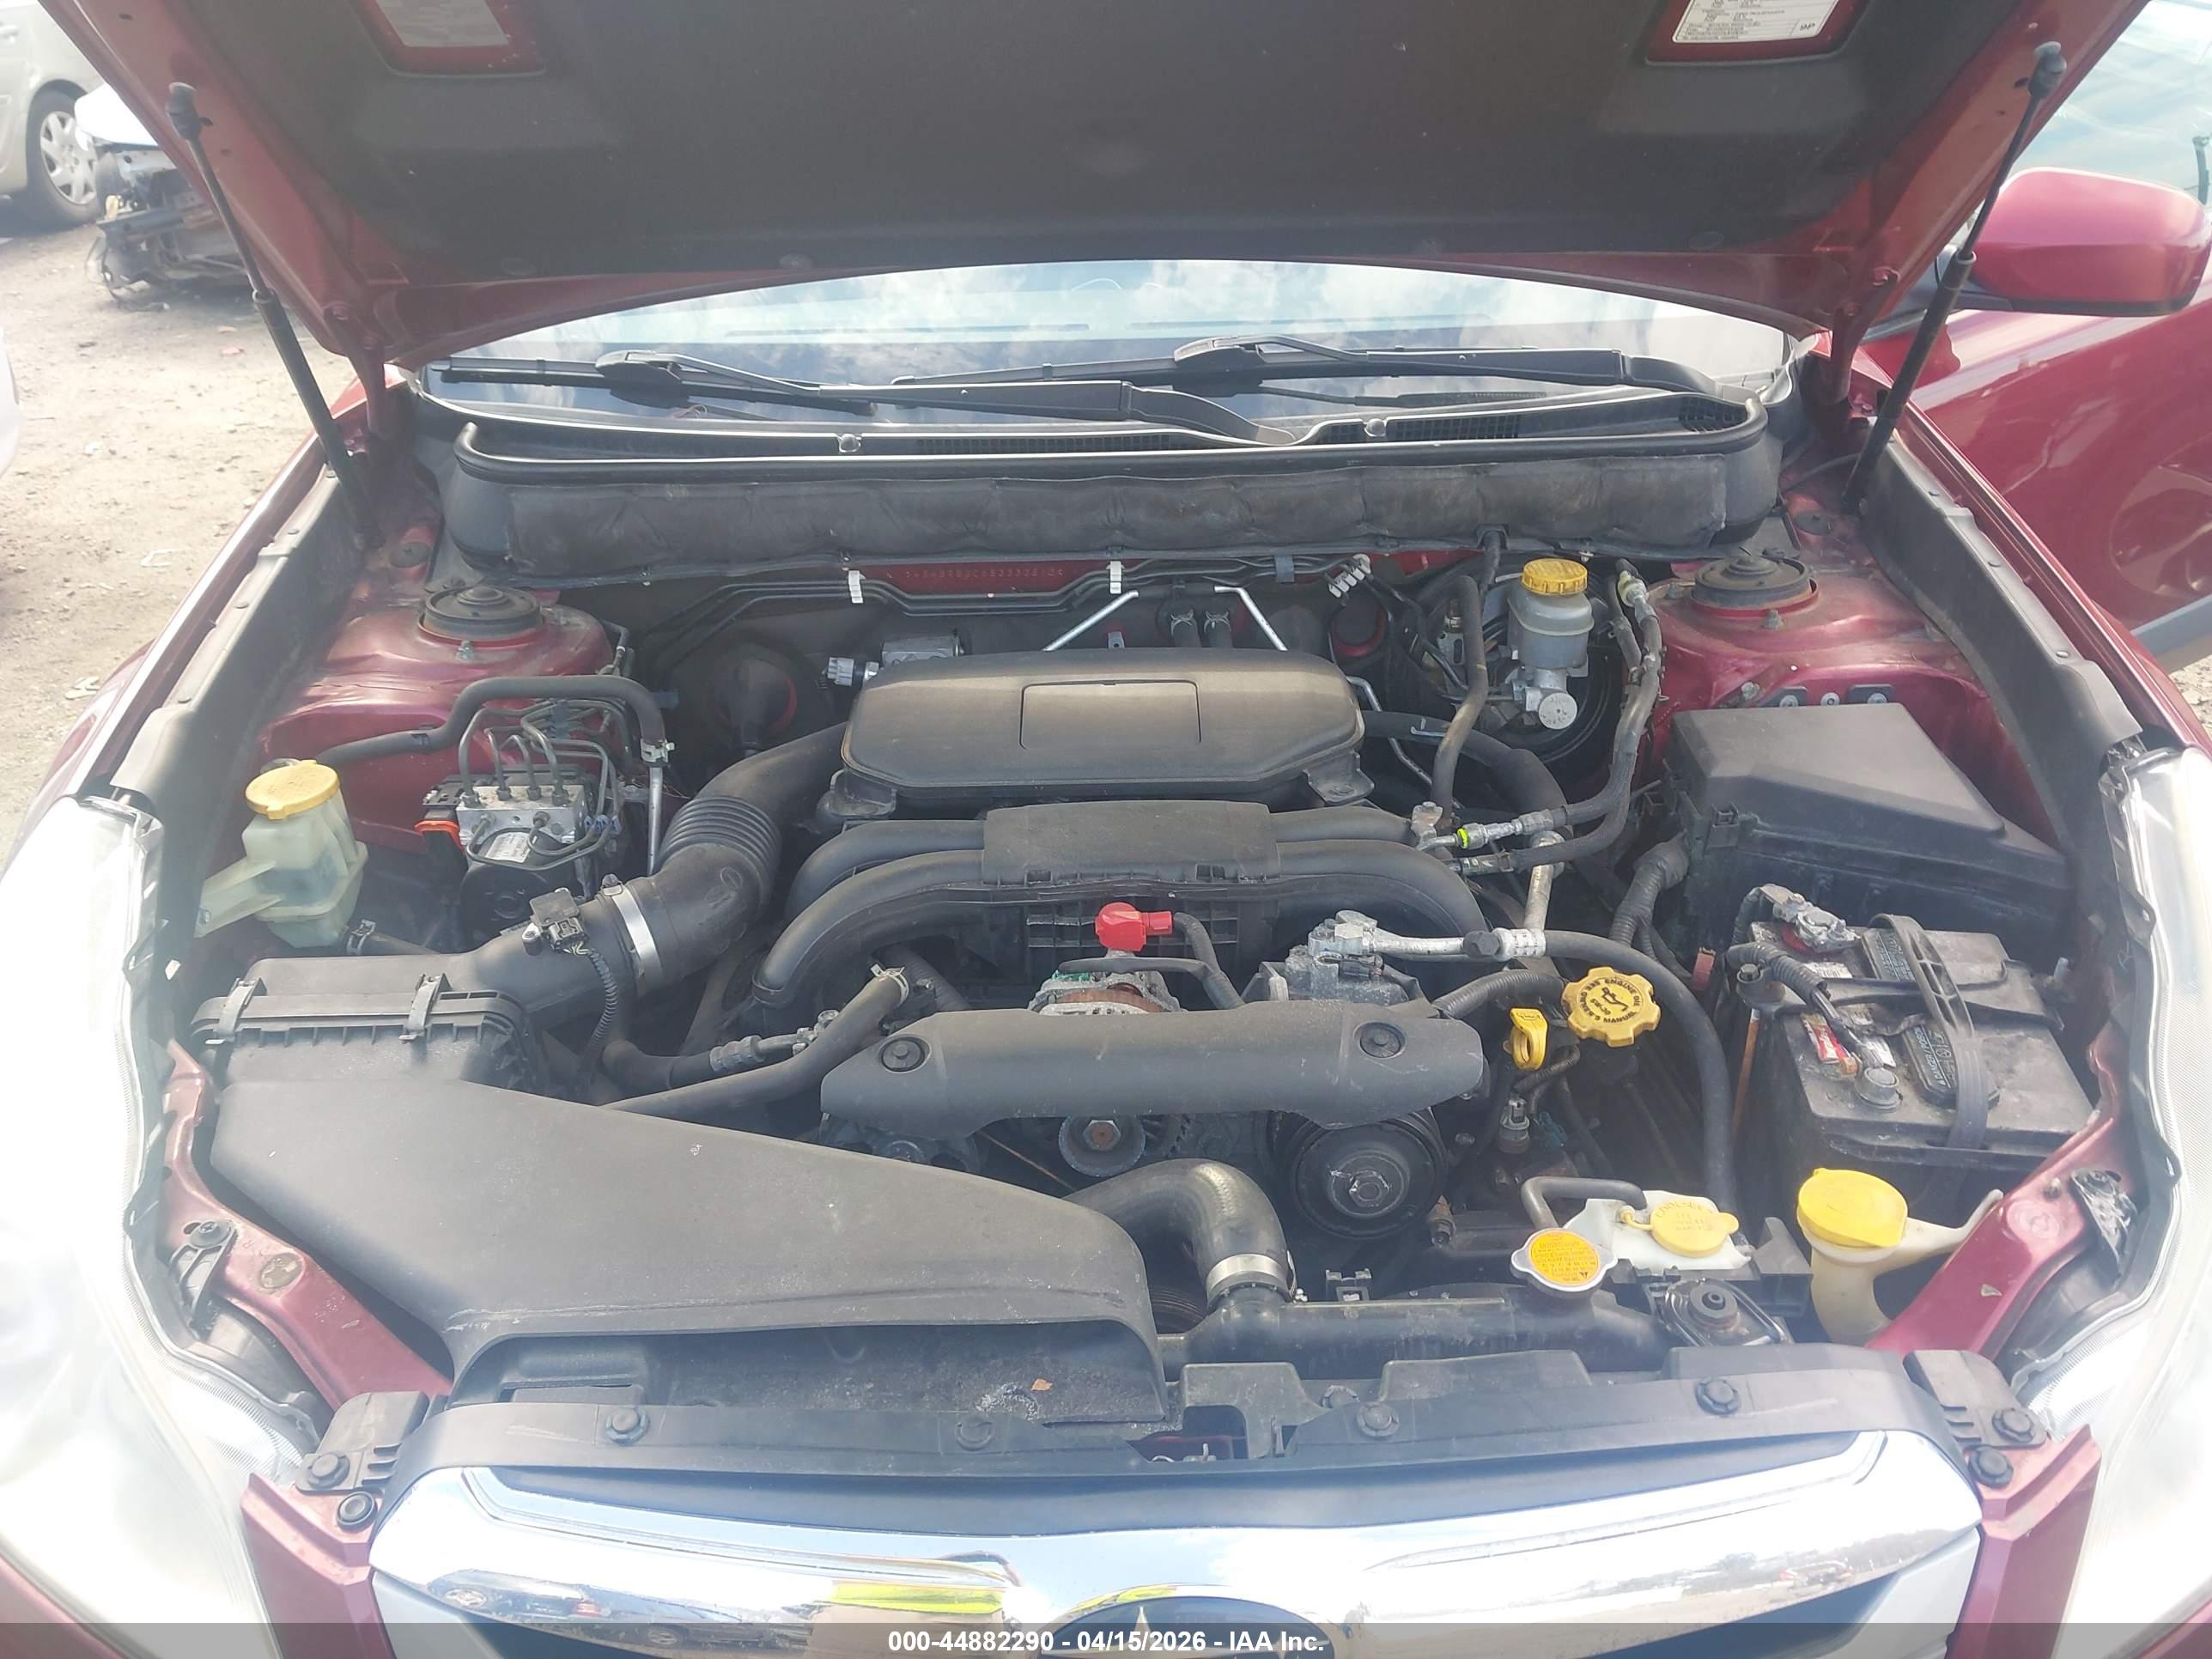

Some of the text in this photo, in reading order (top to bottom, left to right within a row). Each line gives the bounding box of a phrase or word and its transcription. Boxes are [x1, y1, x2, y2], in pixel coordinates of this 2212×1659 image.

[1604, 978, 1642, 1007] ENGINE OIL
[1603, 1011, 1637, 1024] MANUAL
